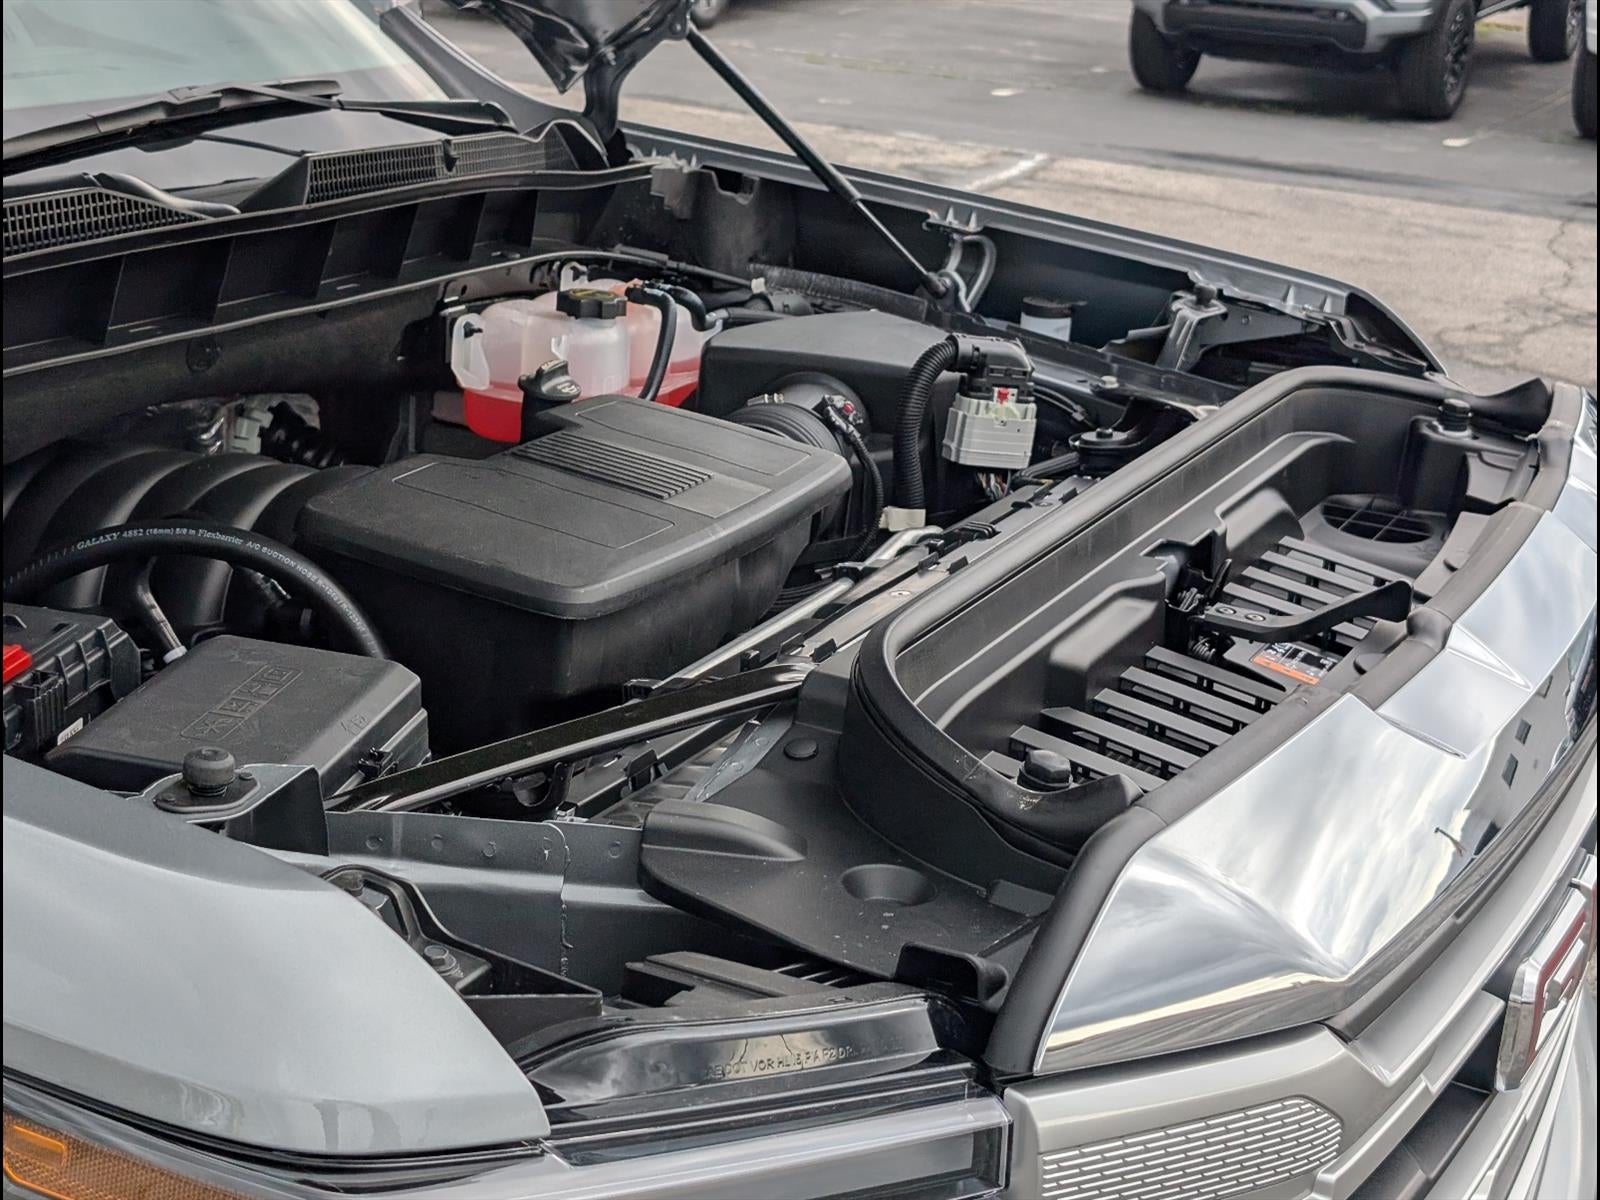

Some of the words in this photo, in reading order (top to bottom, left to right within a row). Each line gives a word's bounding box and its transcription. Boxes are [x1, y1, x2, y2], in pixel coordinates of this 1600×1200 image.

[76, 531, 120, 550] GALAXY
[197, 528, 243, 545] Flexbarrier
[261, 546, 296, 567] SUCTION
[296, 564, 317, 582] HOSE
[725, 1062, 748, 1075] DOT
[750, 1059, 774, 1073] VOR
